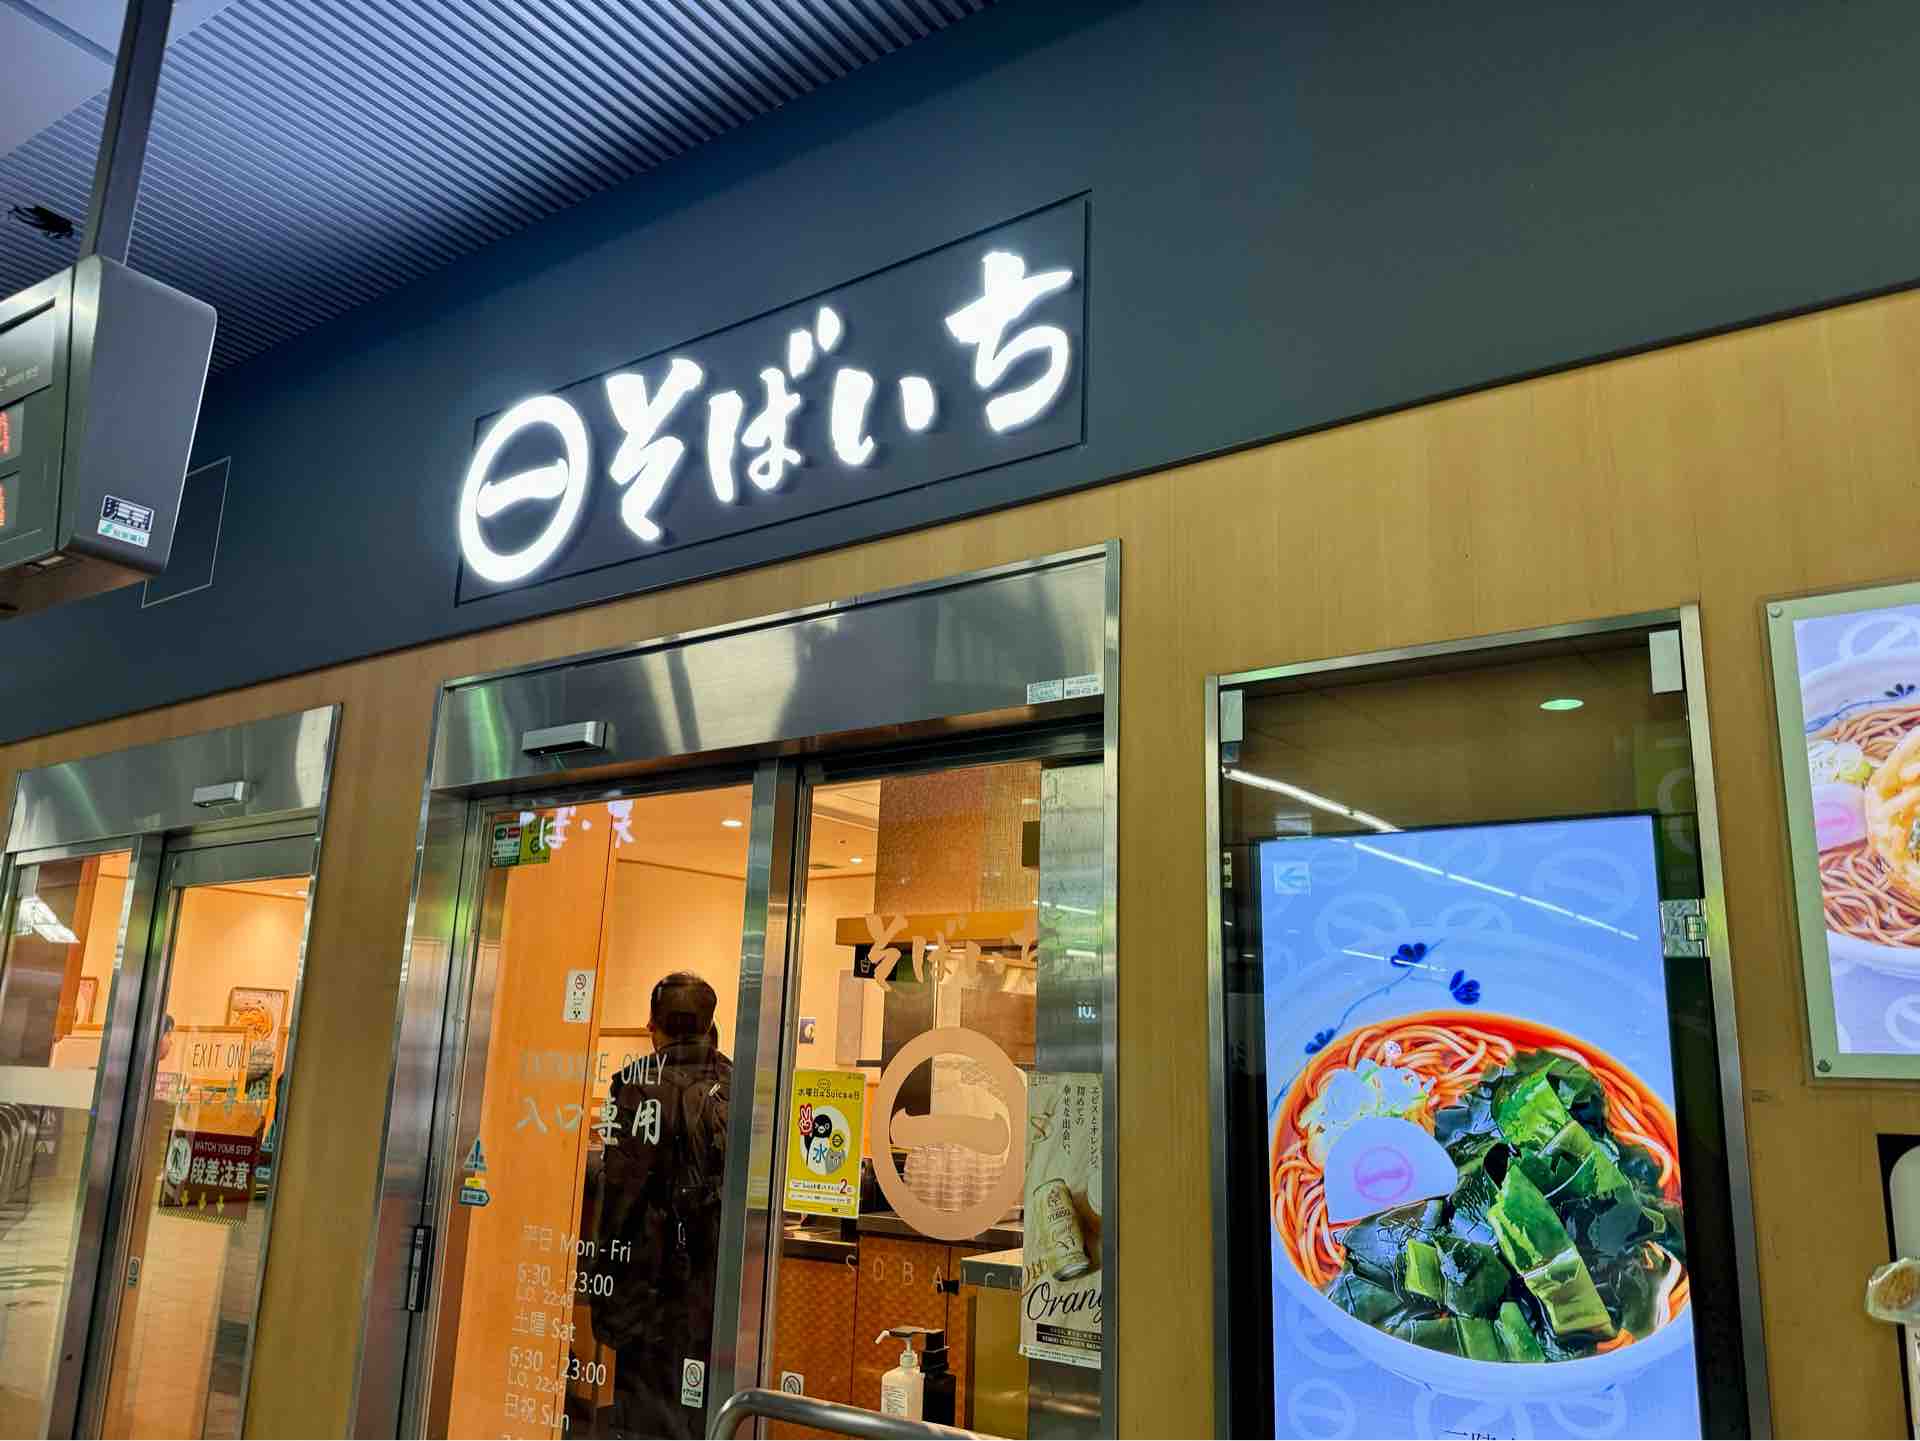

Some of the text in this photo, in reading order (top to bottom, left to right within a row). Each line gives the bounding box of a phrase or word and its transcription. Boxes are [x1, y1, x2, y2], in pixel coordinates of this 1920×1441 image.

[604, 250, 1074, 541] そばいち
[192, 1043, 222, 1070] EXIT
[620, 1053, 669, 1087] ONLY
[512, 1094, 662, 1147] 入口専用
[190, 1156, 249, 1190] 段差注意
[559, 1232, 596, 1258] Mon
[610, 1239, 632, 1264] Fri
[568, 1270, 614, 1297] 23:00
[551, 1317, 577, 1343] Sat
[509, 1346, 544, 1373] 6:30
[561, 1357, 607, 1386] 23:00
[540, 1403, 570, 1432] Sun
